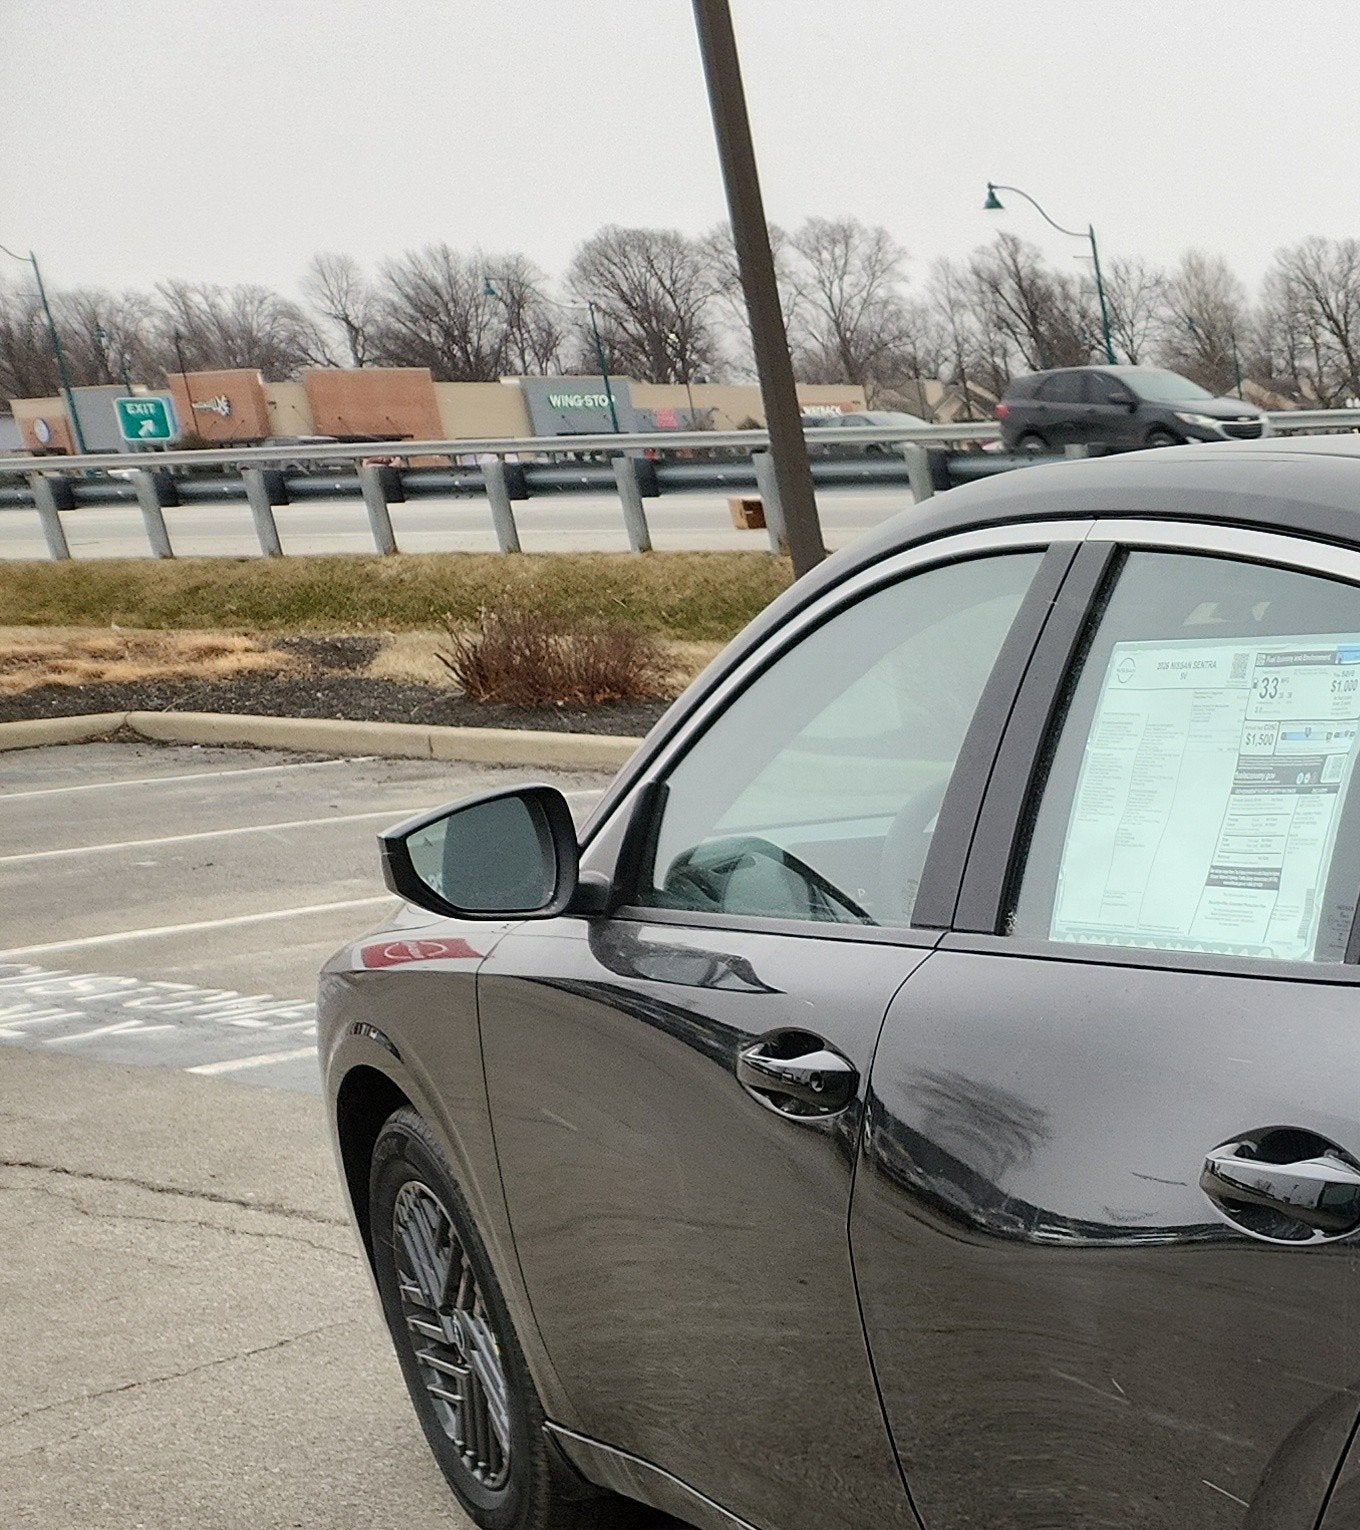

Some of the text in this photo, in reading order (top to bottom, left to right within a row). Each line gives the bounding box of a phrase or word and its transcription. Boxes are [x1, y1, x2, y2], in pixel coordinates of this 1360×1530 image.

[125, 402, 156, 415] EXIT
[1259, 677, 1279, 699] 33
[1245, 732, 1275, 747] $1,500
